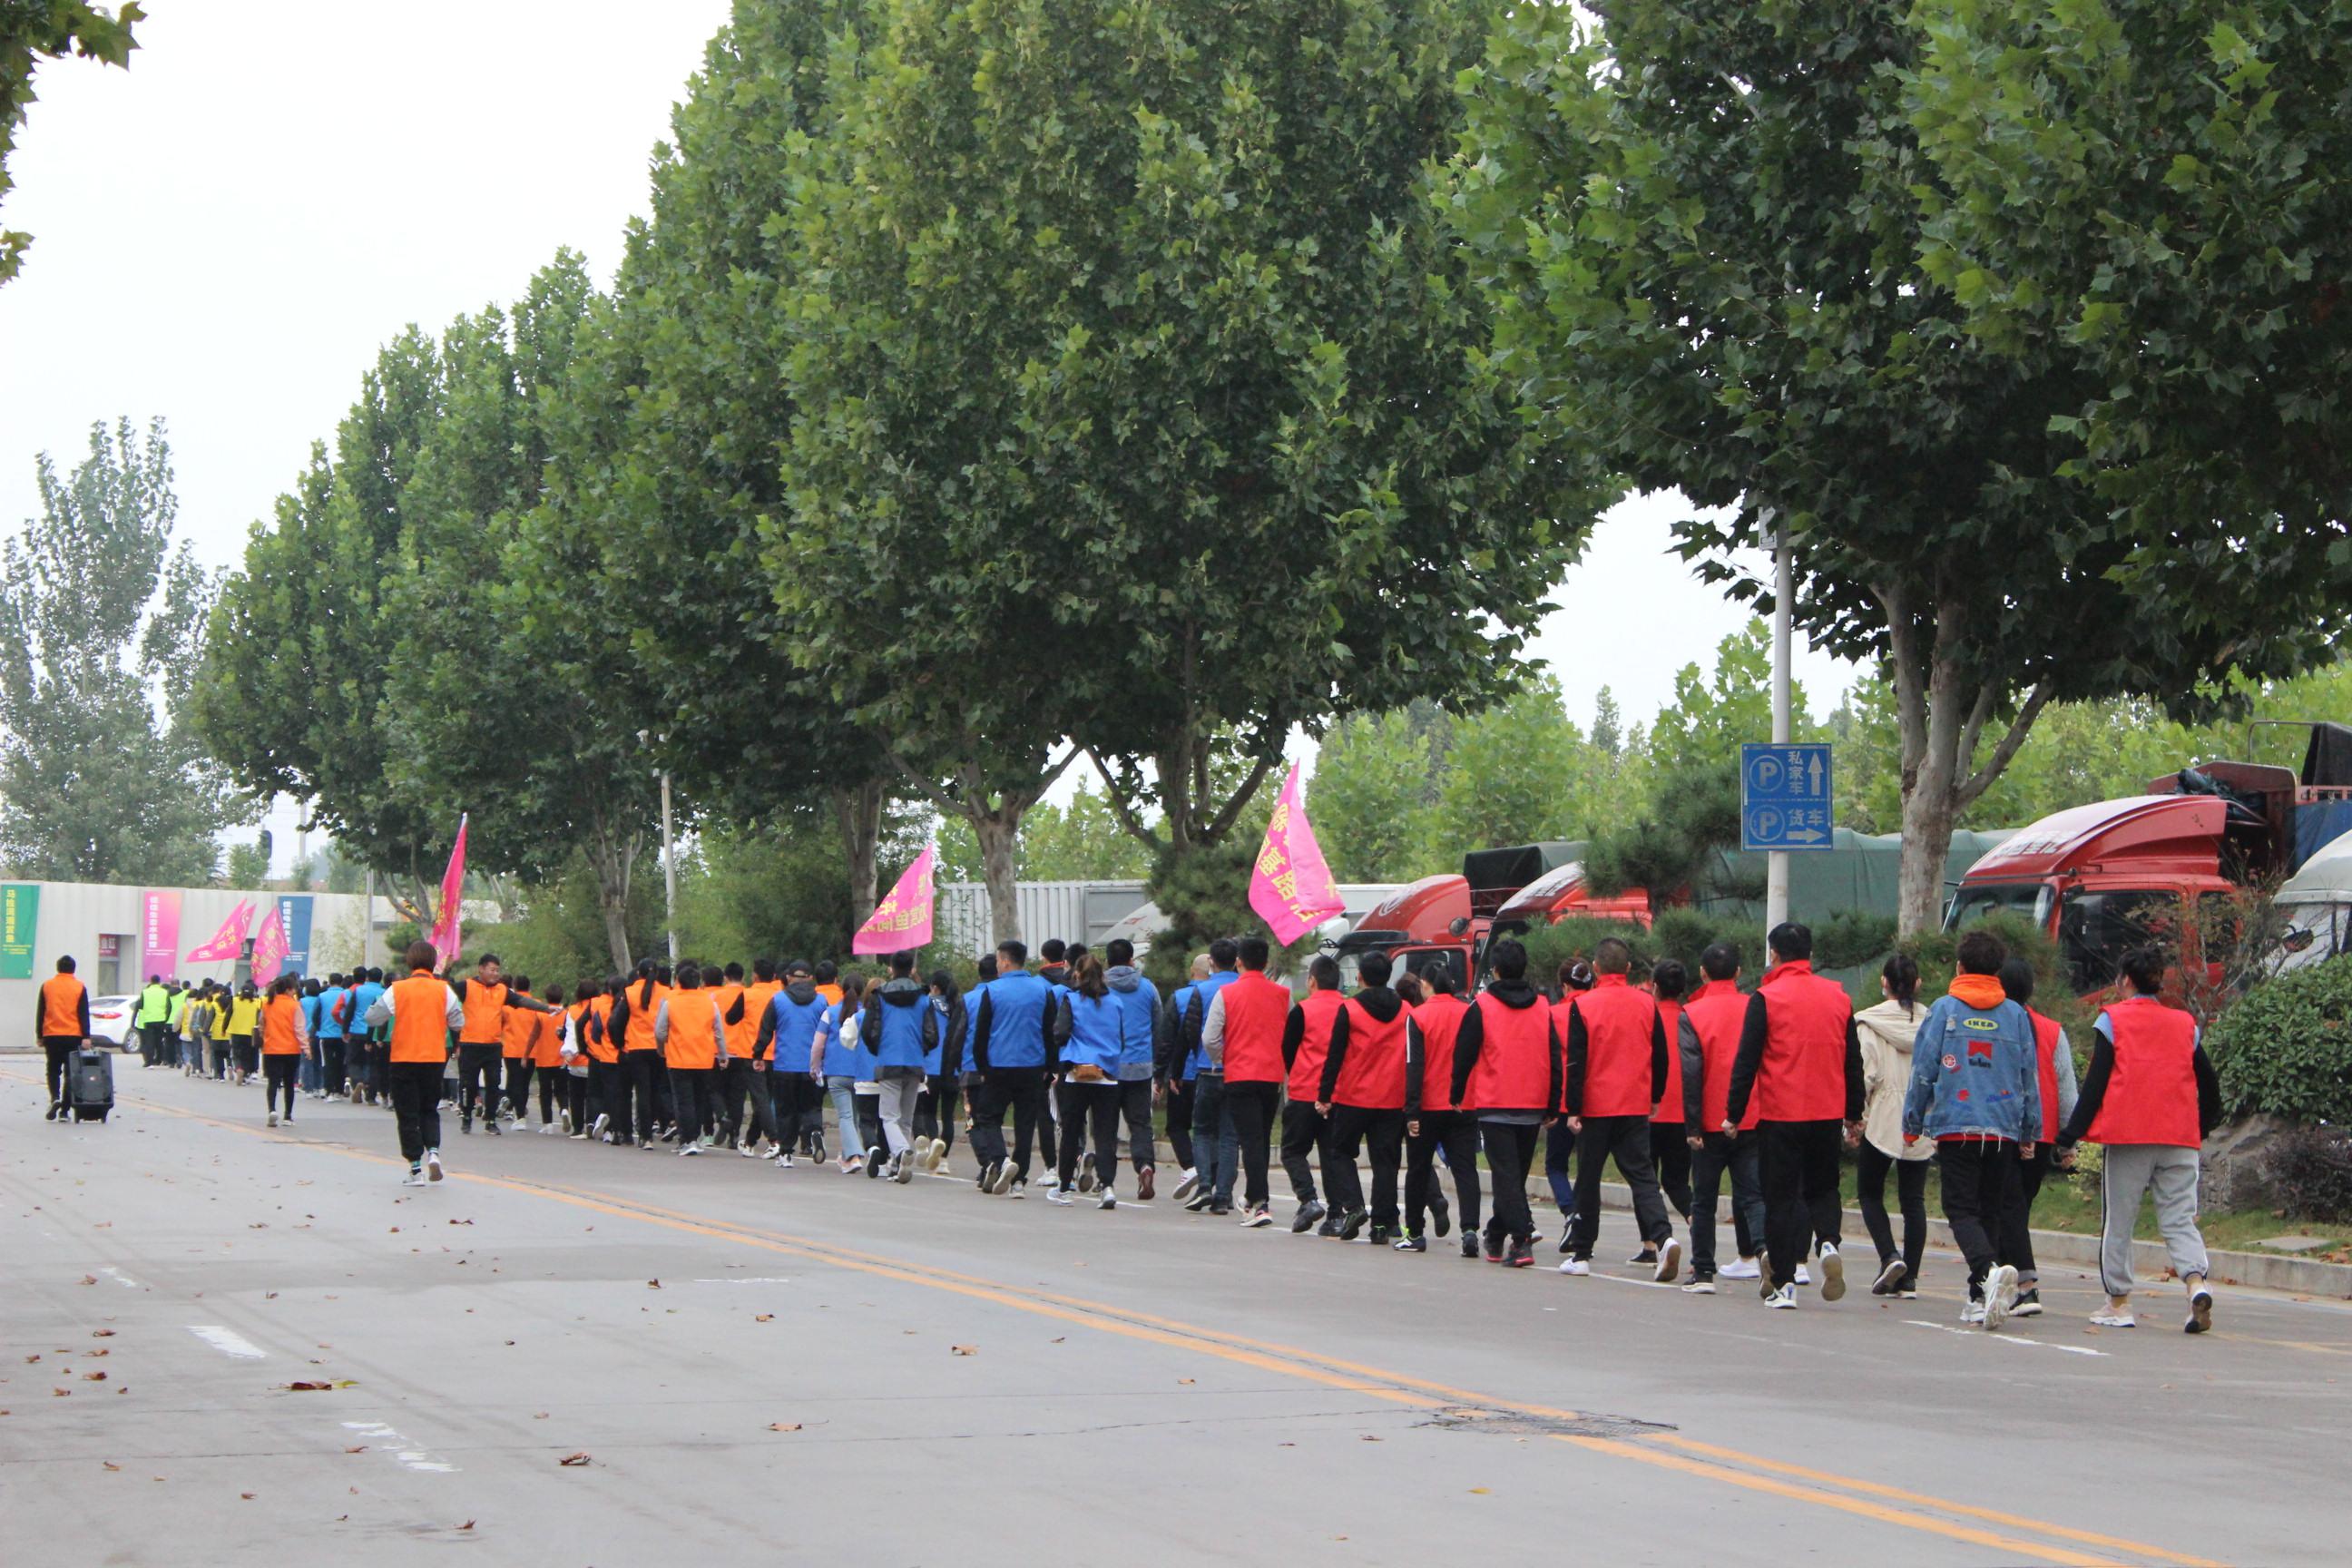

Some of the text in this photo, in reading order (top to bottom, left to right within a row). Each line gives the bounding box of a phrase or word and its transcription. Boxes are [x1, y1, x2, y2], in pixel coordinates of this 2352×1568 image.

[1759, 762, 1778, 786] P
[1788, 750, 1804, 795] 私家车
[1759, 812, 1778, 836] P
[1788, 808, 1824, 827] 货车
[1967, 1020, 1994, 1028] IKEA
